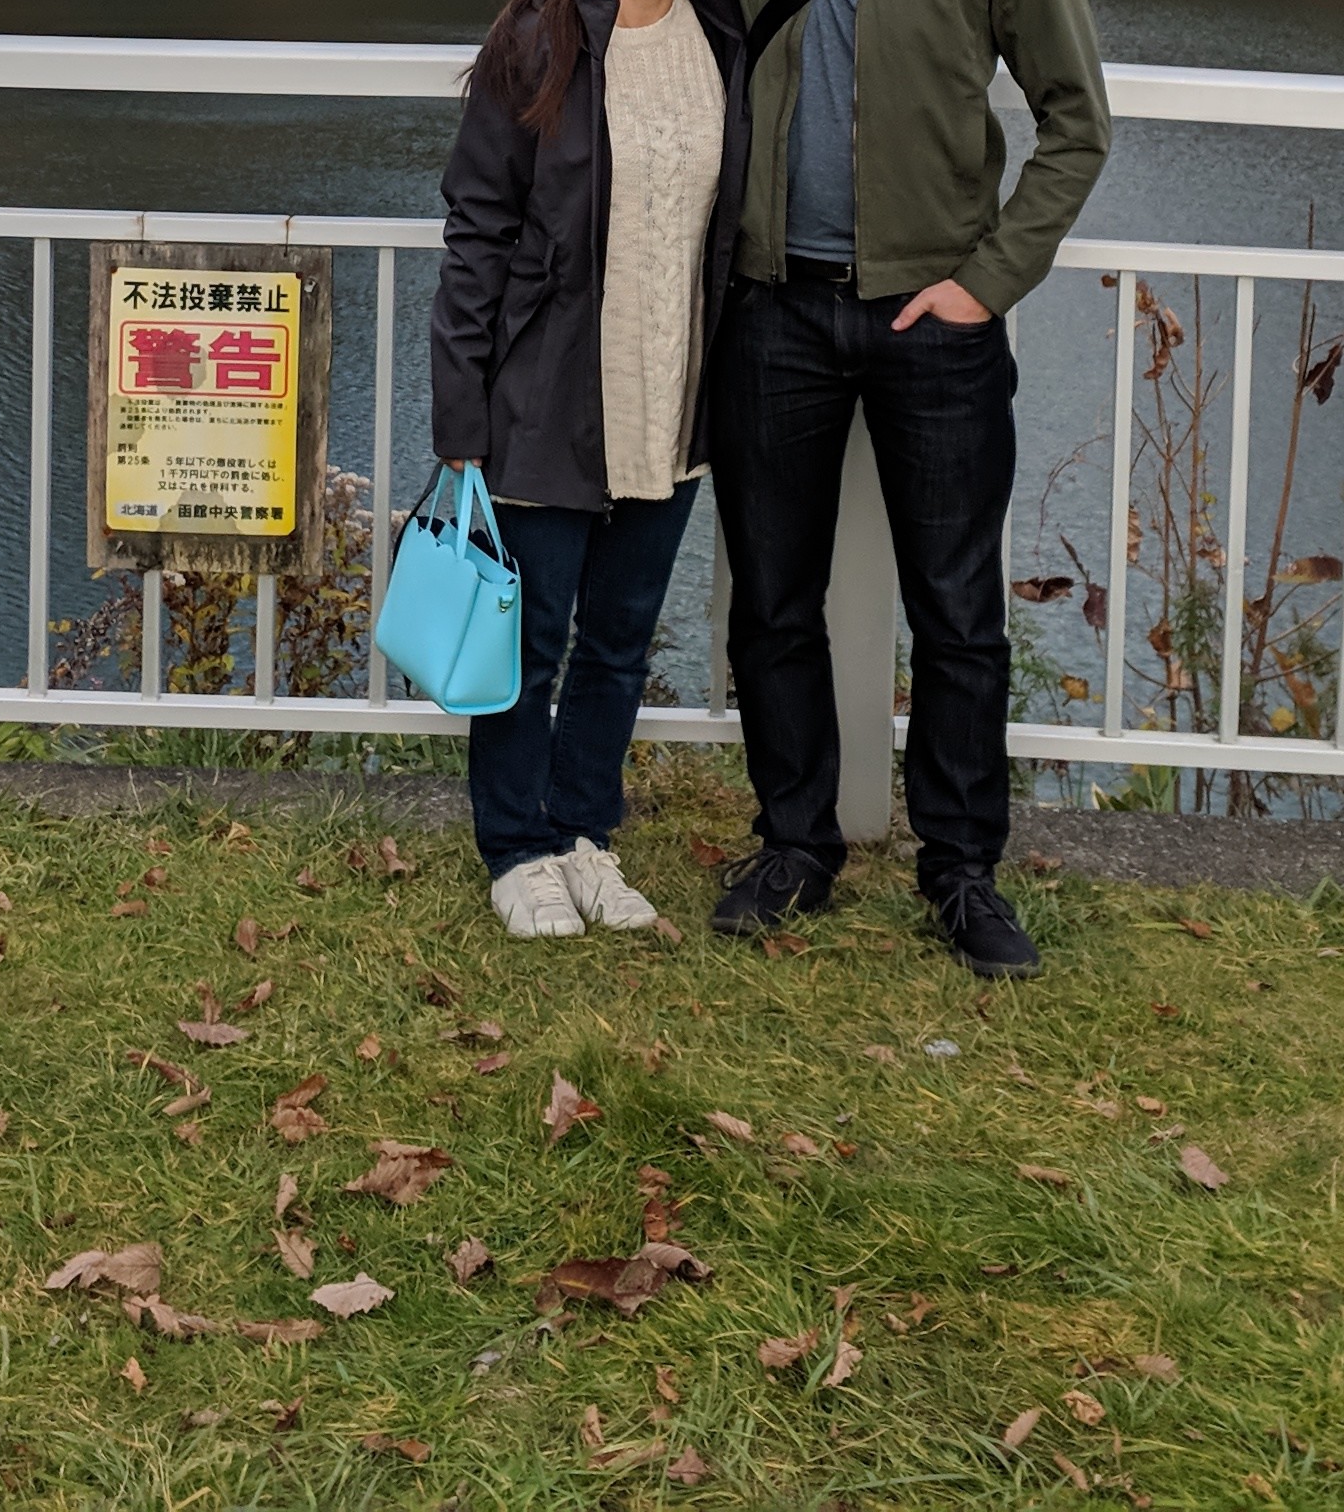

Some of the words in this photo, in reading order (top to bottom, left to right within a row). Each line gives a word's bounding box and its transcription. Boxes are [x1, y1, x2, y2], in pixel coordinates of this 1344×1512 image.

[123, 280, 290, 313] 不法投棄禁止
[128, 328, 281, 391] 警告
[117, 455, 151, 466] 第25条
